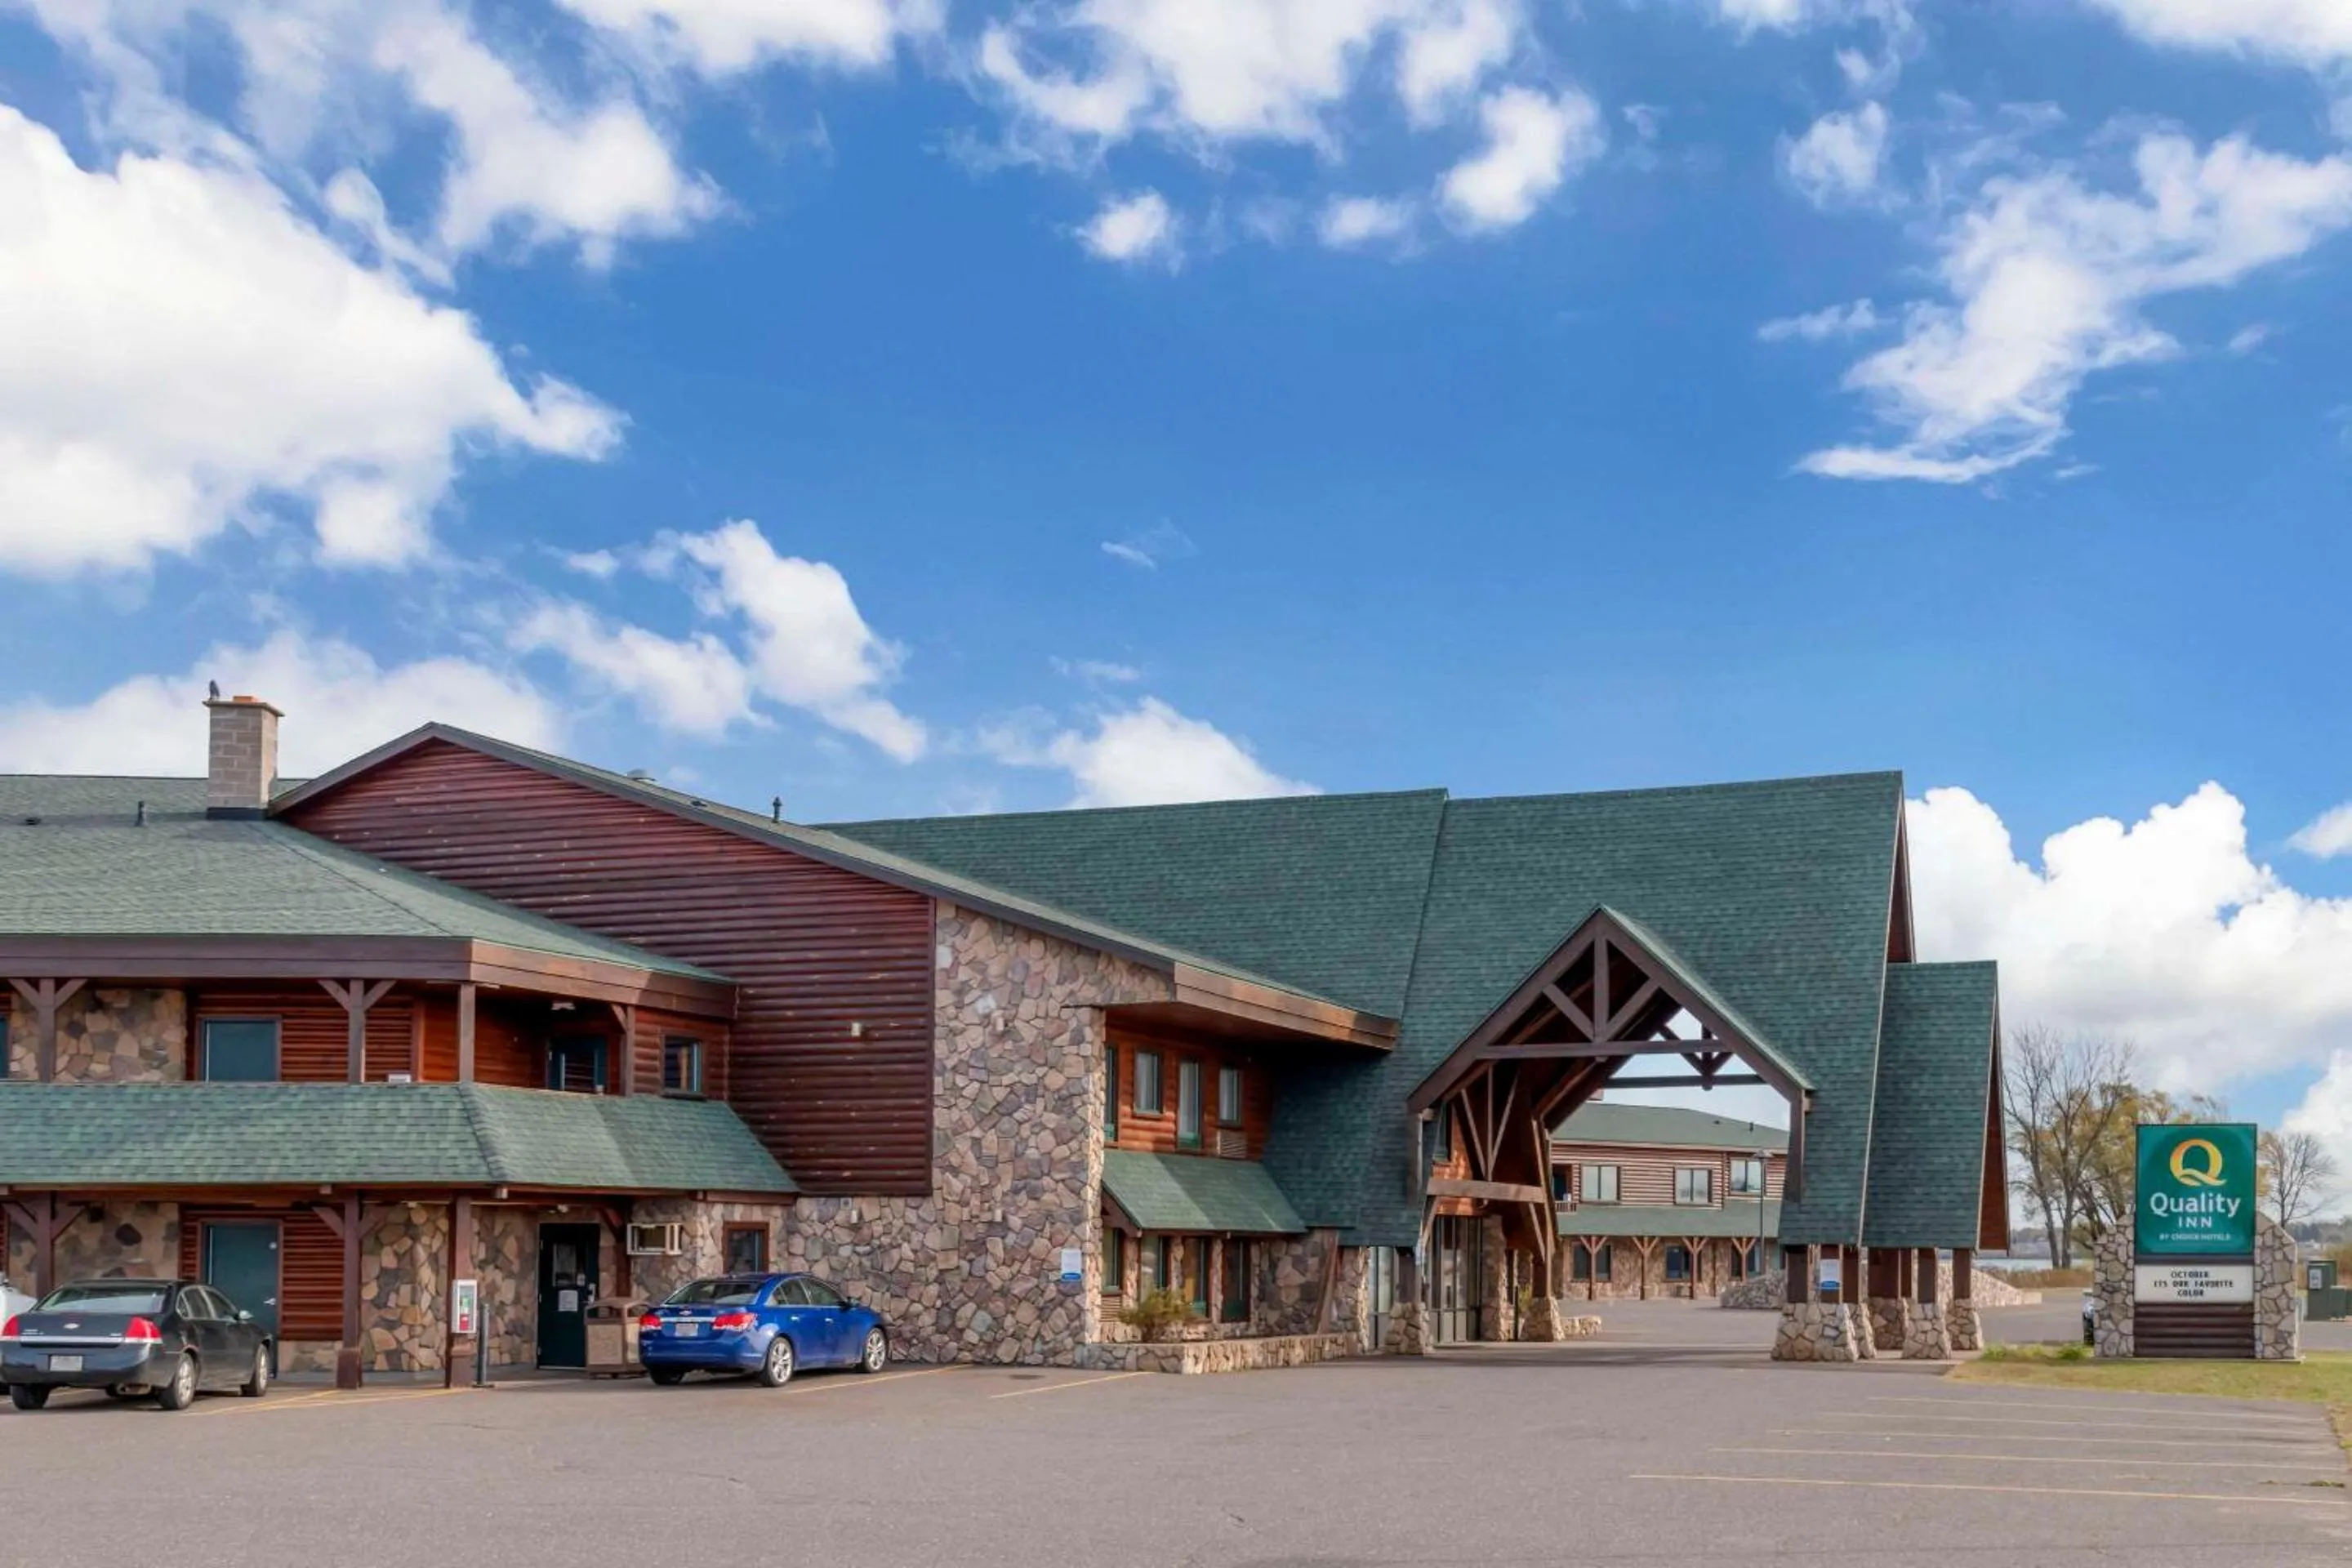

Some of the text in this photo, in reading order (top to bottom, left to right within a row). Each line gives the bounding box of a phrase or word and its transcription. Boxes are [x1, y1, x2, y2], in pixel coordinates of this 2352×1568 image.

[2170, 1138, 2227, 1186] Q
[2149, 1192, 2241, 1217] Quality
[2178, 1216, 2212, 1228] INN
[2171, 1271, 2208, 1279] OCTOBER
[2194, 1280, 2234, 1288] FAVORITE
[2177, 1289, 2204, 1297] COLOR
